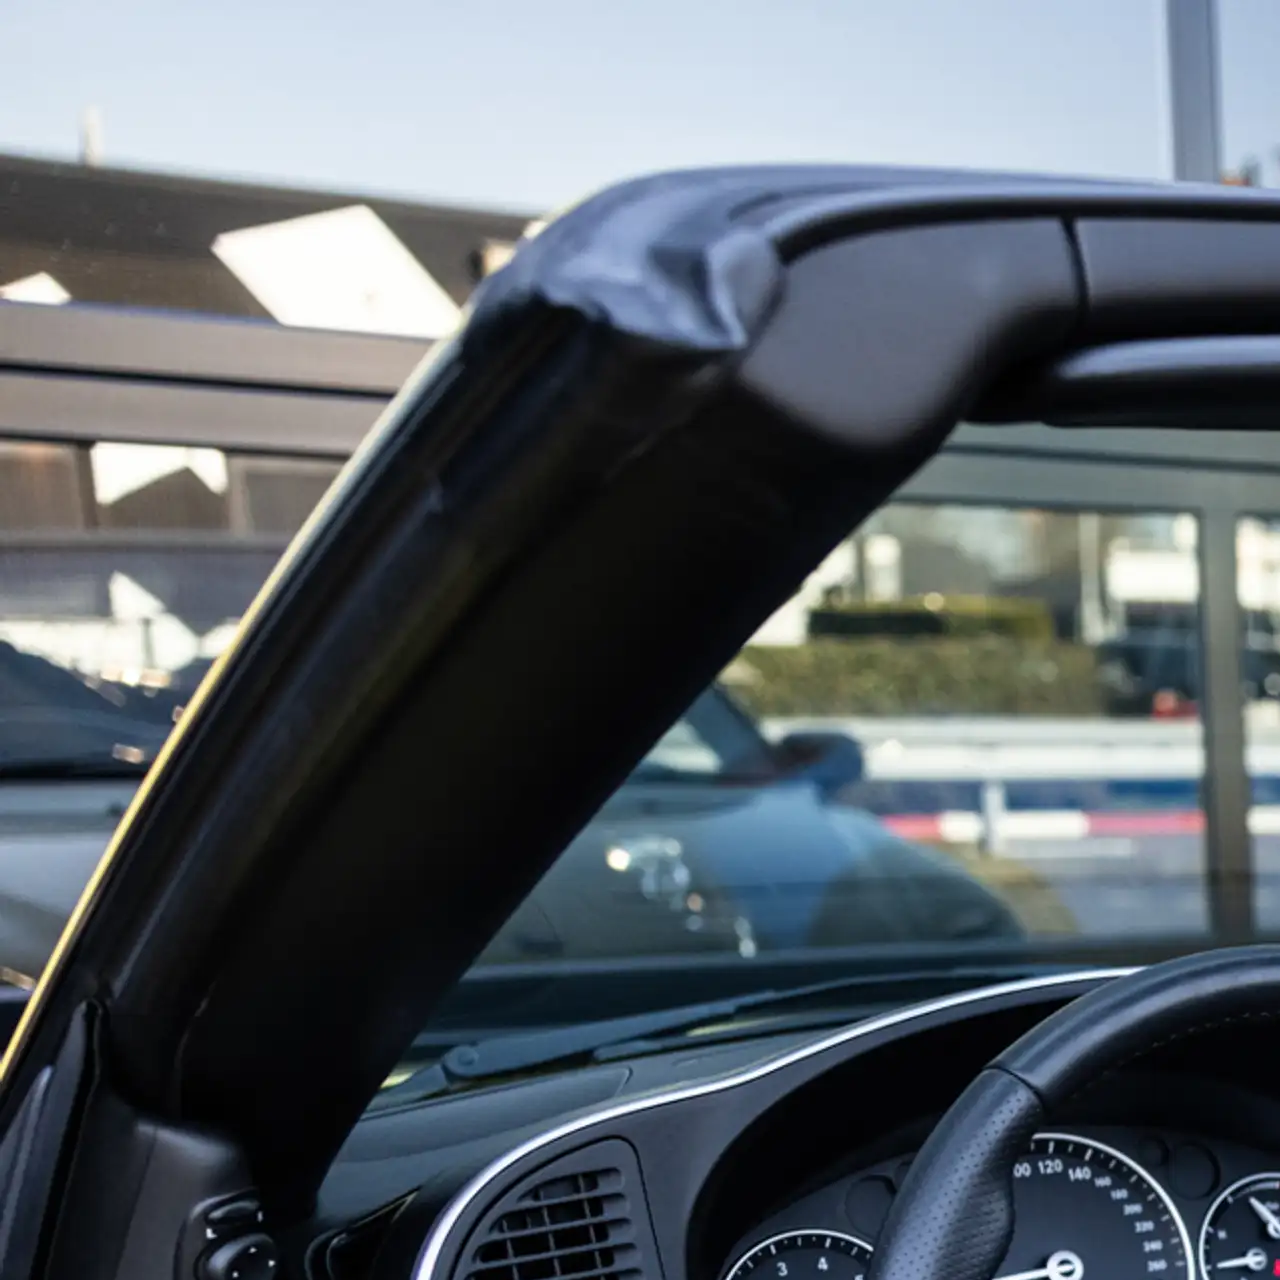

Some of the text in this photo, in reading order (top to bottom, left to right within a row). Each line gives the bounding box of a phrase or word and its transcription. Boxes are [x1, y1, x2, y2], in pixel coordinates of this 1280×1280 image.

[1013, 1162, 1031, 1178] 00
[1037, 1159, 1063, 1175] 120
[1068, 1166, 1091, 1181] 140
[1094, 1176, 1112, 1187] 160
[1111, 1188, 1128, 1200] 180
[1123, 1203, 1143, 1216] 200
[1135, 1221, 1154, 1233] 220
[1143, 1240, 1163, 1252] 240
[777, 1262, 788, 1276] 3
[818, 1256, 828, 1271] 4
[1147, 1259, 1167, 1272] 260
